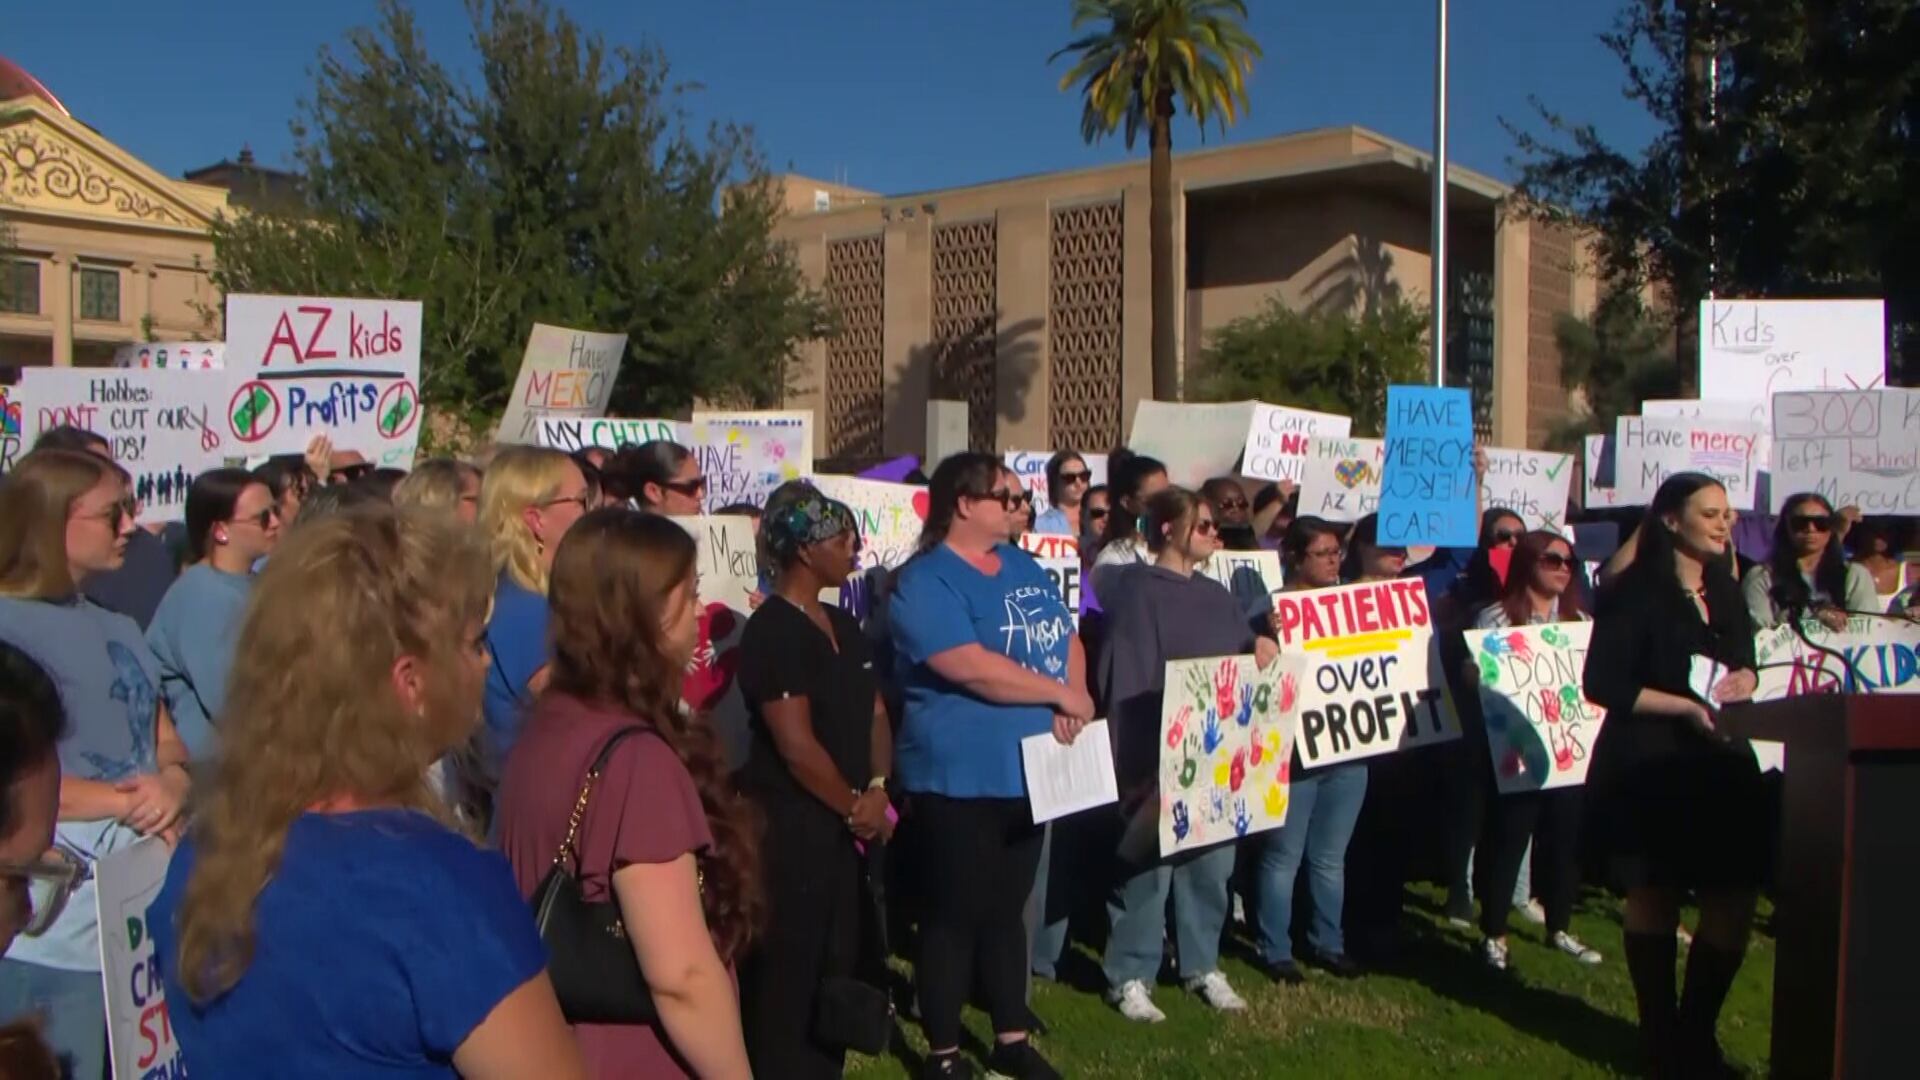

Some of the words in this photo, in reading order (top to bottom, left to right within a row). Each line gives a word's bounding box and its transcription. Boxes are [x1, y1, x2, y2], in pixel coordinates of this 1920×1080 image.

[262, 306, 337, 366] AZ
[350, 310, 402, 358] kids
[1764, 351, 1801, 366] over
[288, 381, 378, 427] Profits
[524, 369, 610, 408] MERCY
[110, 409, 152, 429] CUT
[1397, 399, 1461, 426] HAVE
[1784, 394, 1875, 436] 300
[544, 420, 583, 450] MY
[1384, 437, 1472, 468] MERCY
[1626, 419, 1684, 448] Have
[1690, 427, 1757, 460] mercy
[1487, 452, 1539, 477] ents
[1780, 439, 1832, 472] left
[1321, 491, 1346, 514] AZ
[1278, 580, 1429, 644] PATIENTS
[1316, 655, 1398, 694] over
[1301, 687, 1444, 761] PROFIT
[1548, 722, 1585, 764] US
